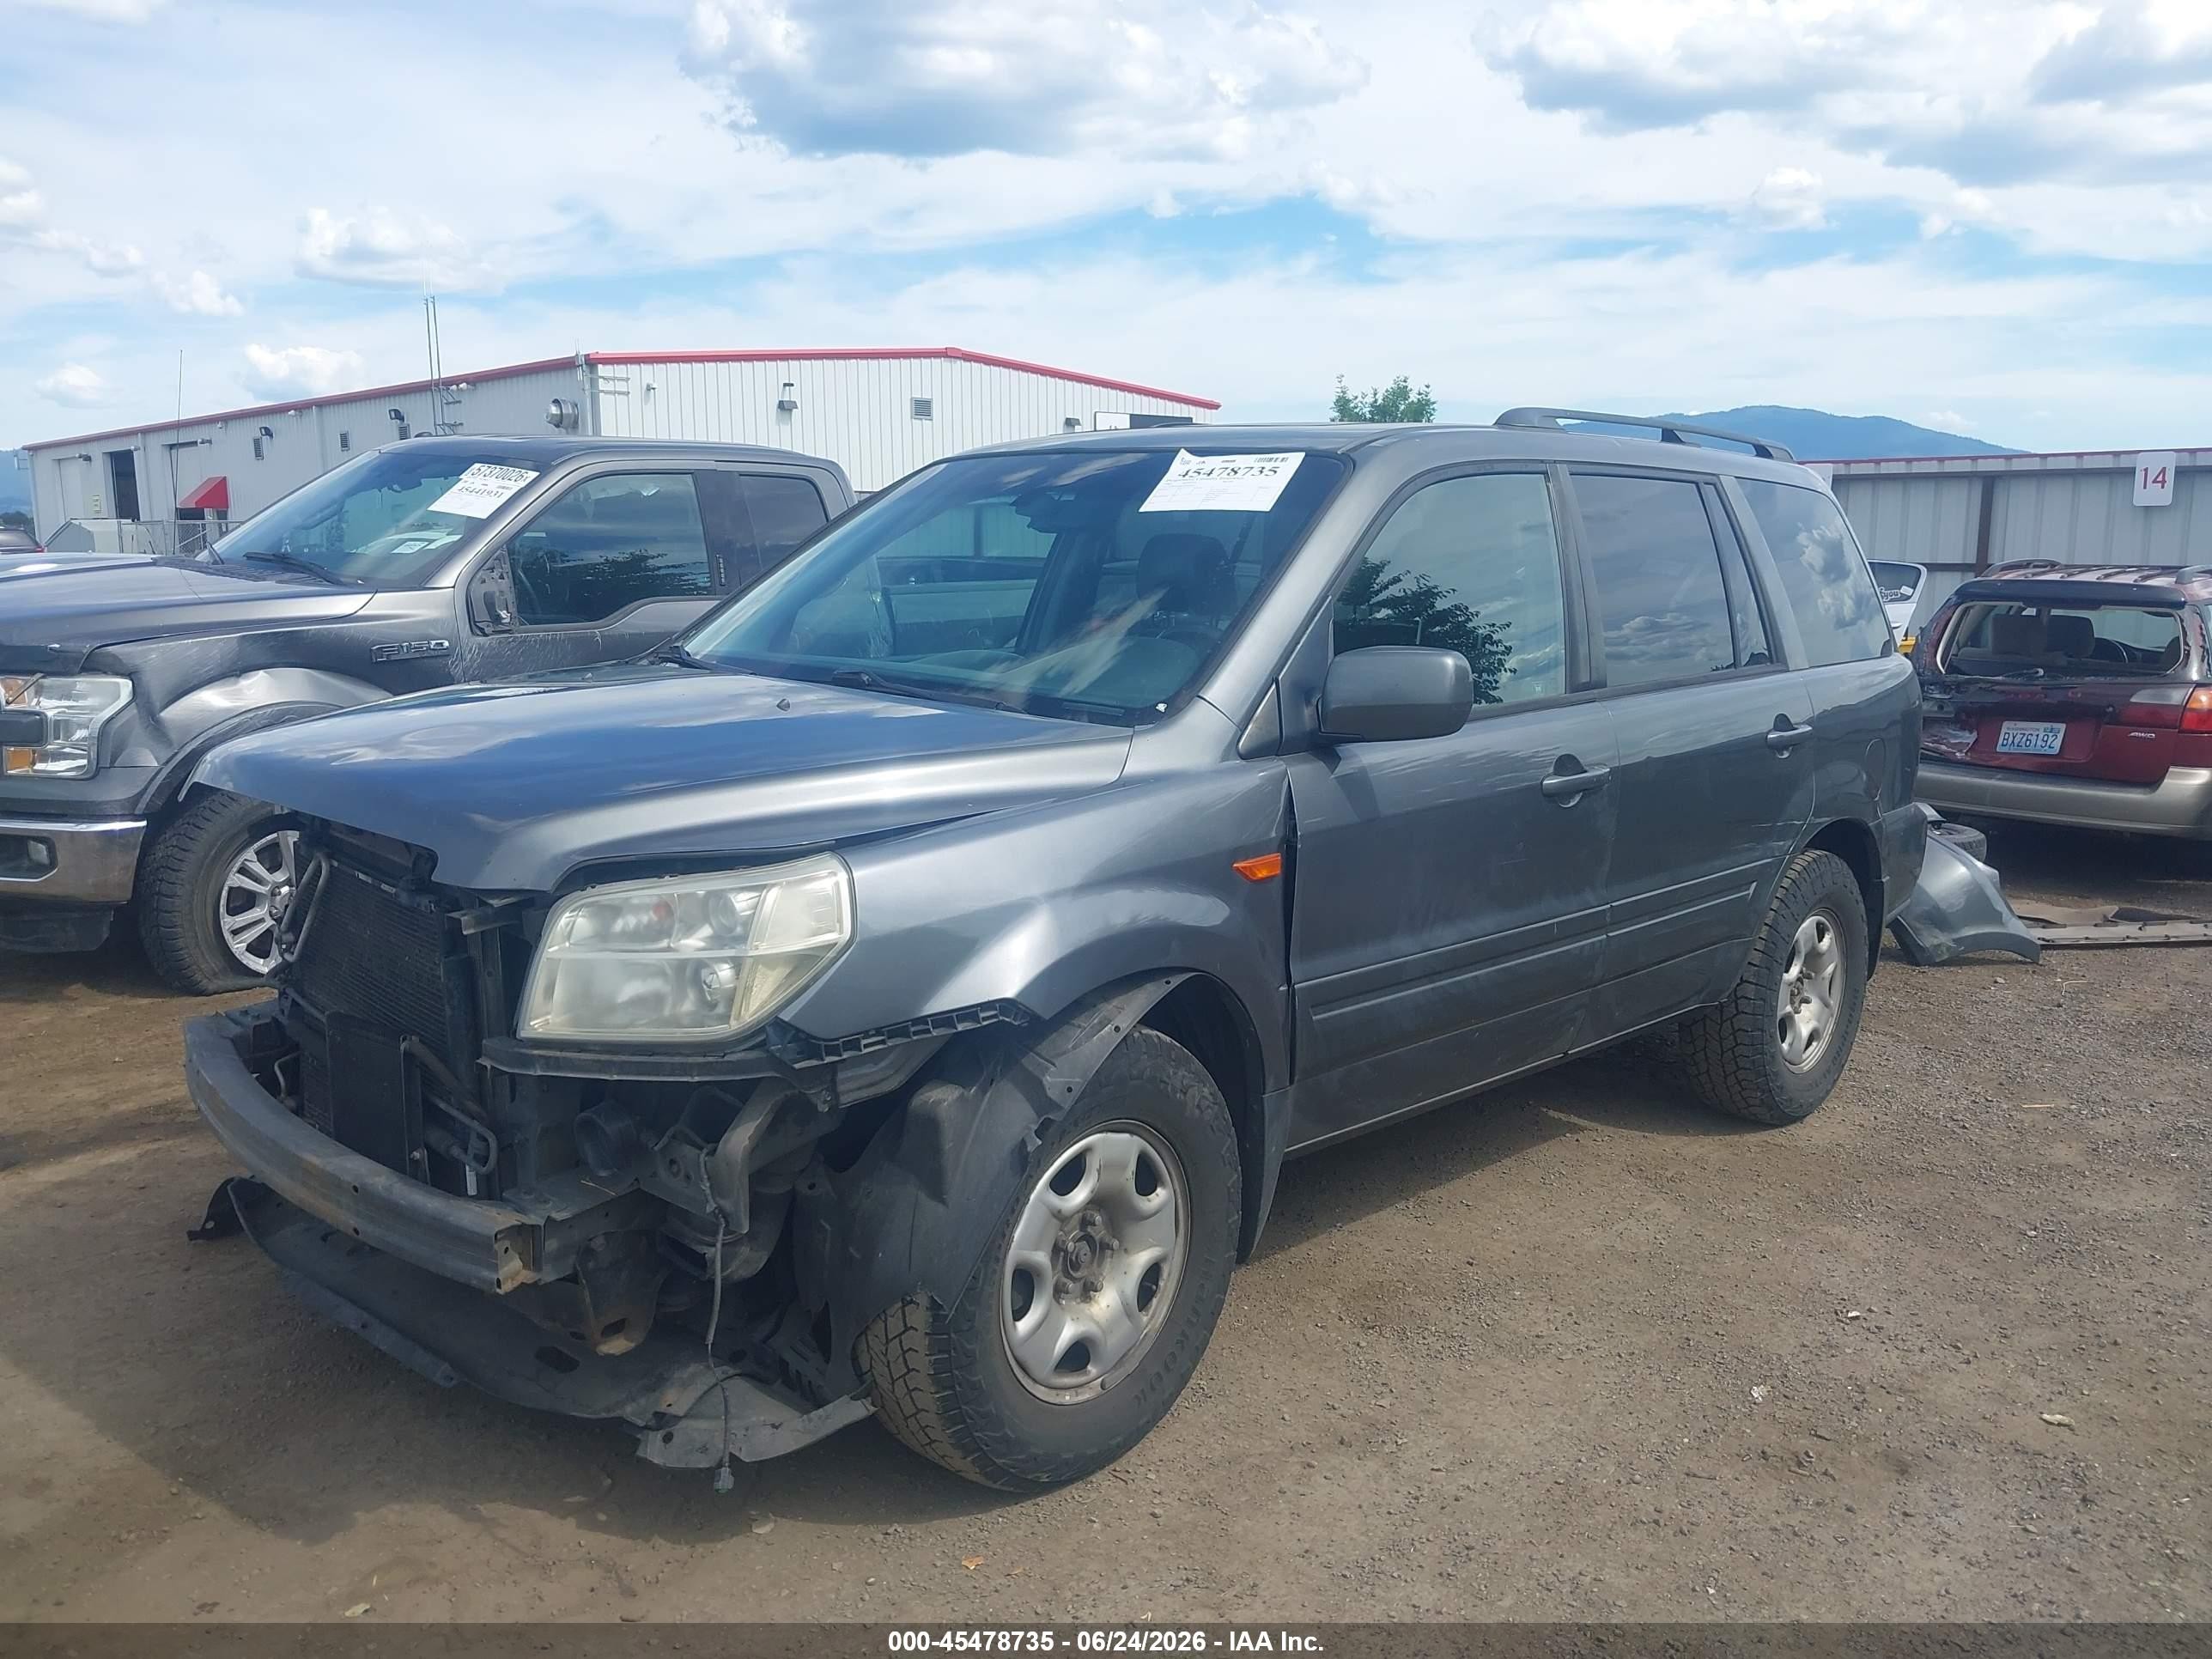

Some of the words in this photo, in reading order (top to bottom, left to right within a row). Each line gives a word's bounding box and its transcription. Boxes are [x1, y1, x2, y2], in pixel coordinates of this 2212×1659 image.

[1177, 466, 1279, 478] 45478735
[2140, 466, 2167, 489] 14
[2001, 732, 2058, 749] BXZ6192
